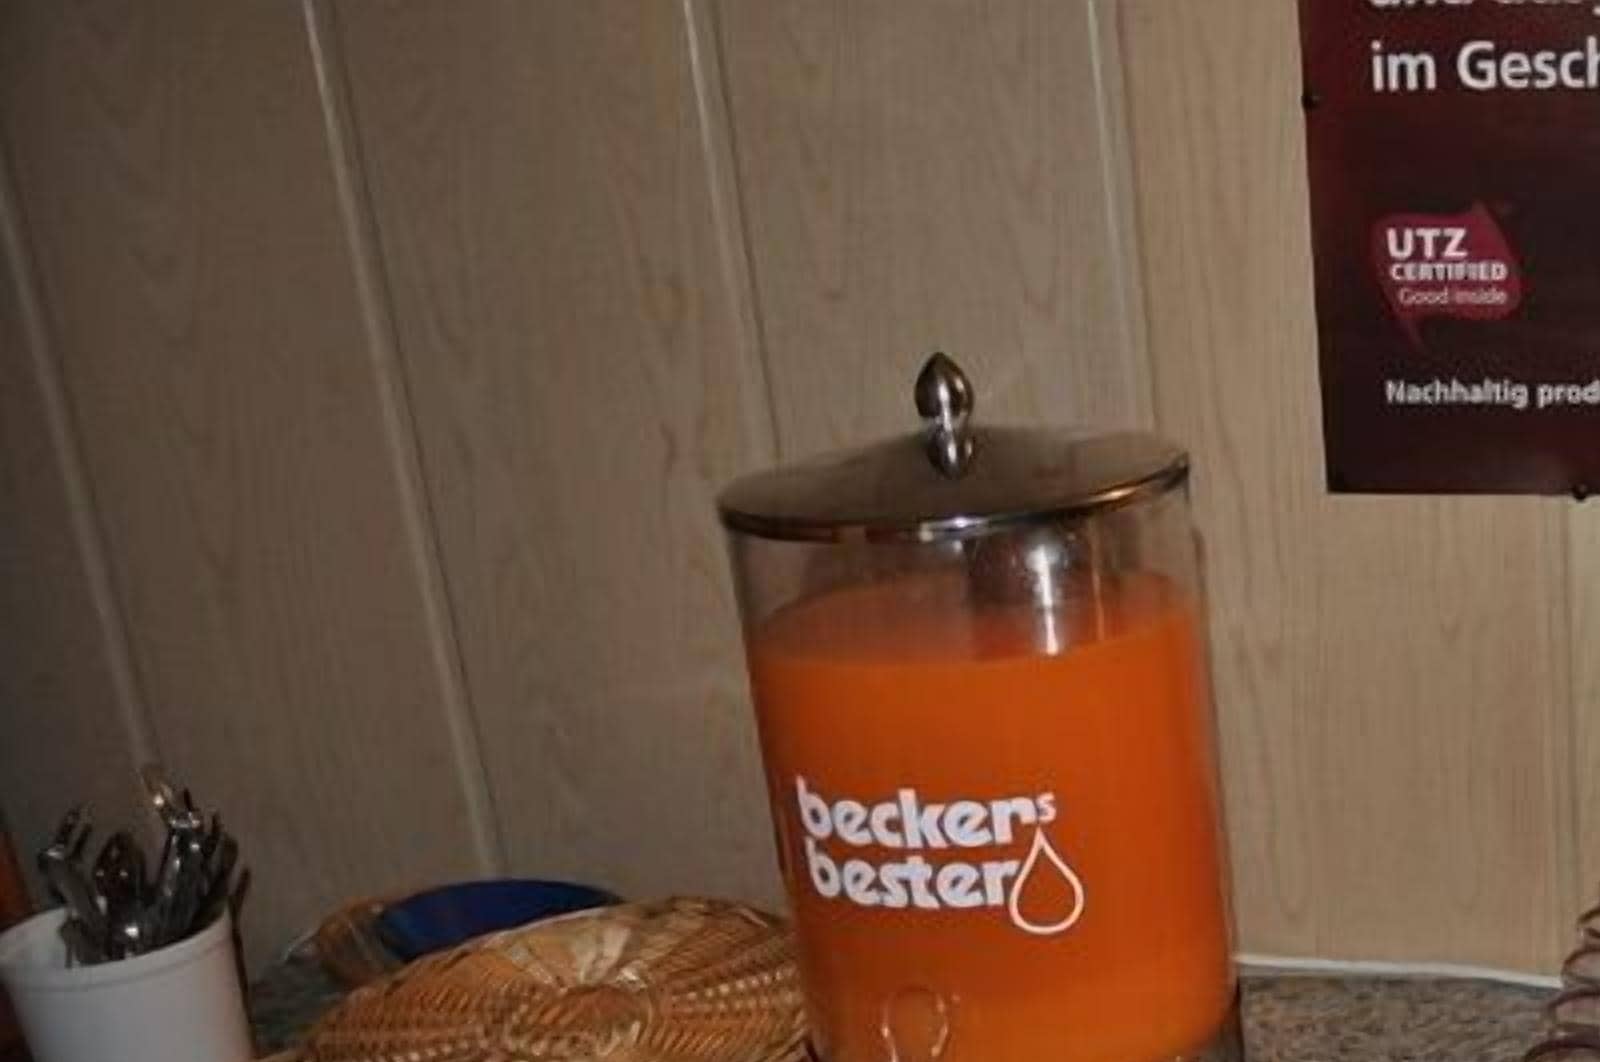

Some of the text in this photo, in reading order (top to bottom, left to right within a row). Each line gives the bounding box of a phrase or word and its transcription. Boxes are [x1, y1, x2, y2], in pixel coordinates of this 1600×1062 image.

[1370, 40, 1437, 91] im
[1386, 227, 1468, 259] UTZ
[1389, 261, 1508, 282] CERTIFIED
[1385, 379, 1528, 410] Nachhaltig
[797, 775, 1056, 849] beckers
[805, 836, 1021, 910] bester
